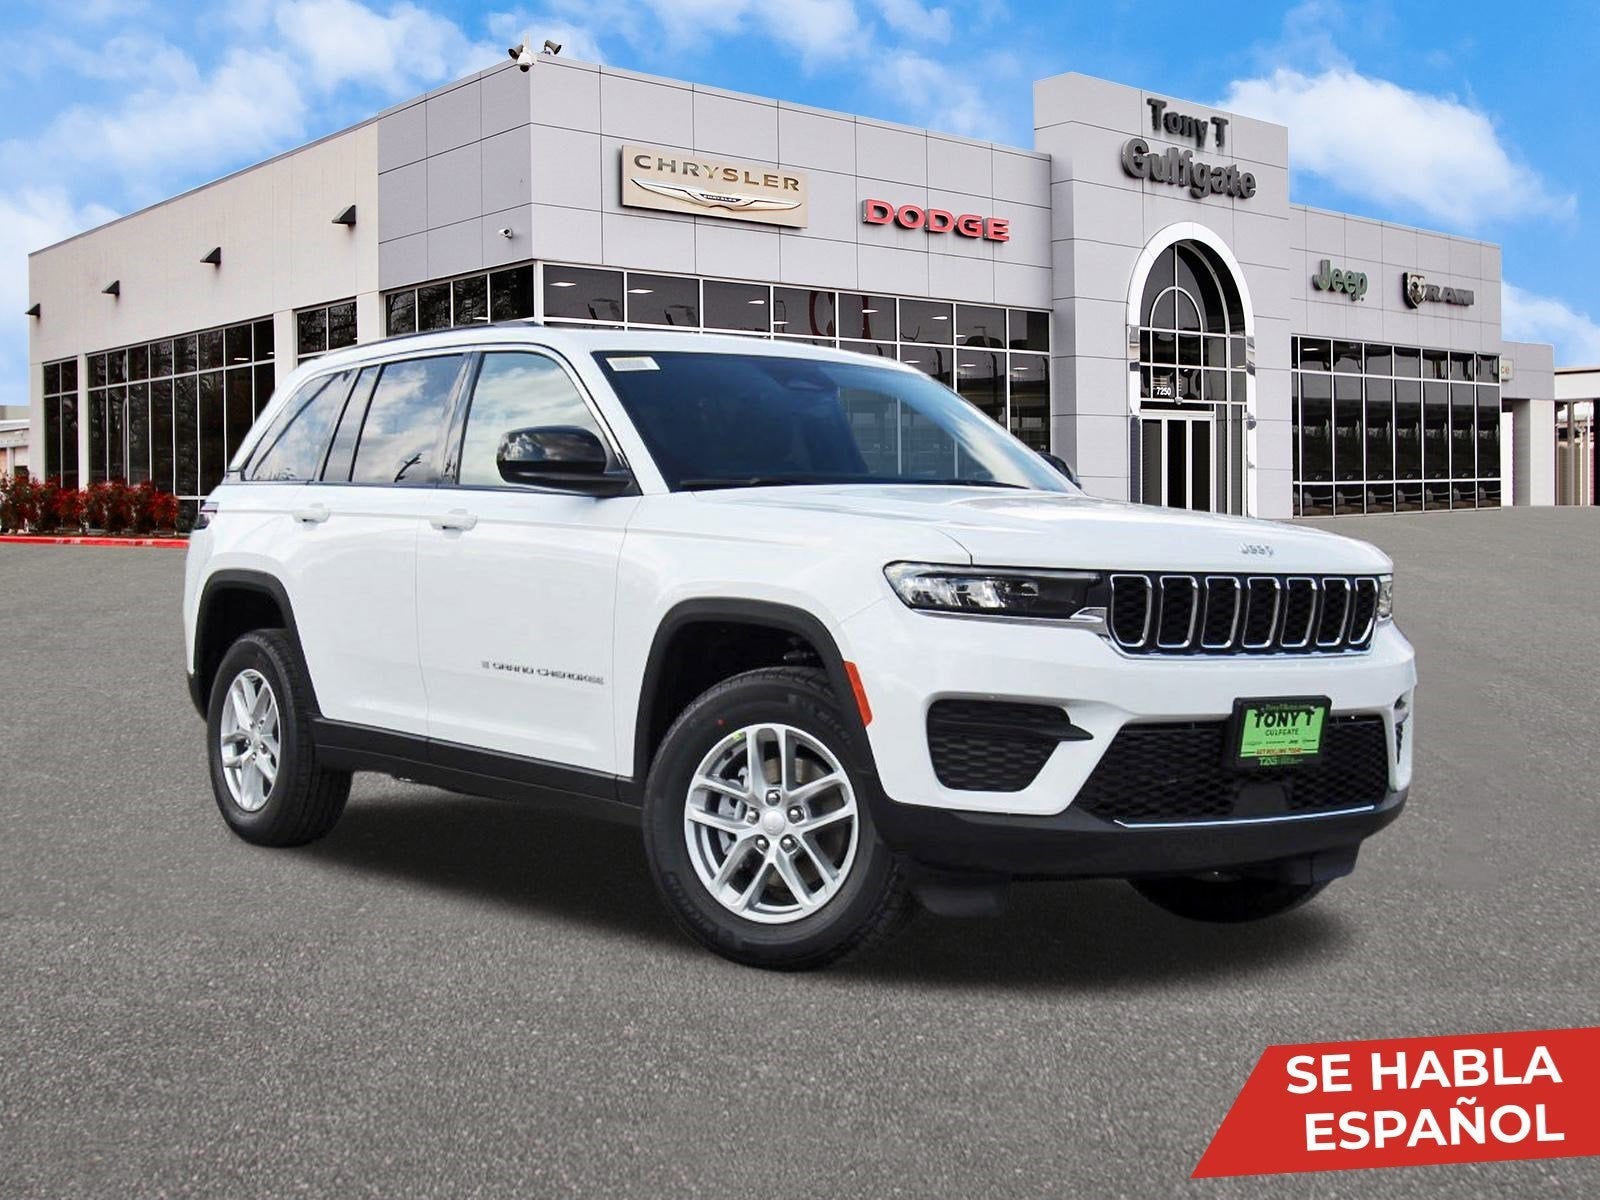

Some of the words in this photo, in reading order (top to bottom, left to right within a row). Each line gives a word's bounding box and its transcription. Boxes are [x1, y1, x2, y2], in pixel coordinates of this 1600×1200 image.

[1146, 98, 1208, 147] Tony
[1210, 116, 1229, 147] T
[633, 154, 800, 191] CHRYSLER
[1121, 137, 1257, 199] Gulfgate
[862, 199, 1010, 242] DODGE
[1312, 259, 1368, 302] Jeep
[1424, 284, 1474, 306] RAM
[492, 662, 534, 675] GRAND
[1254, 711, 1301, 728] TONY
[1305, 711, 1315, 726] T
